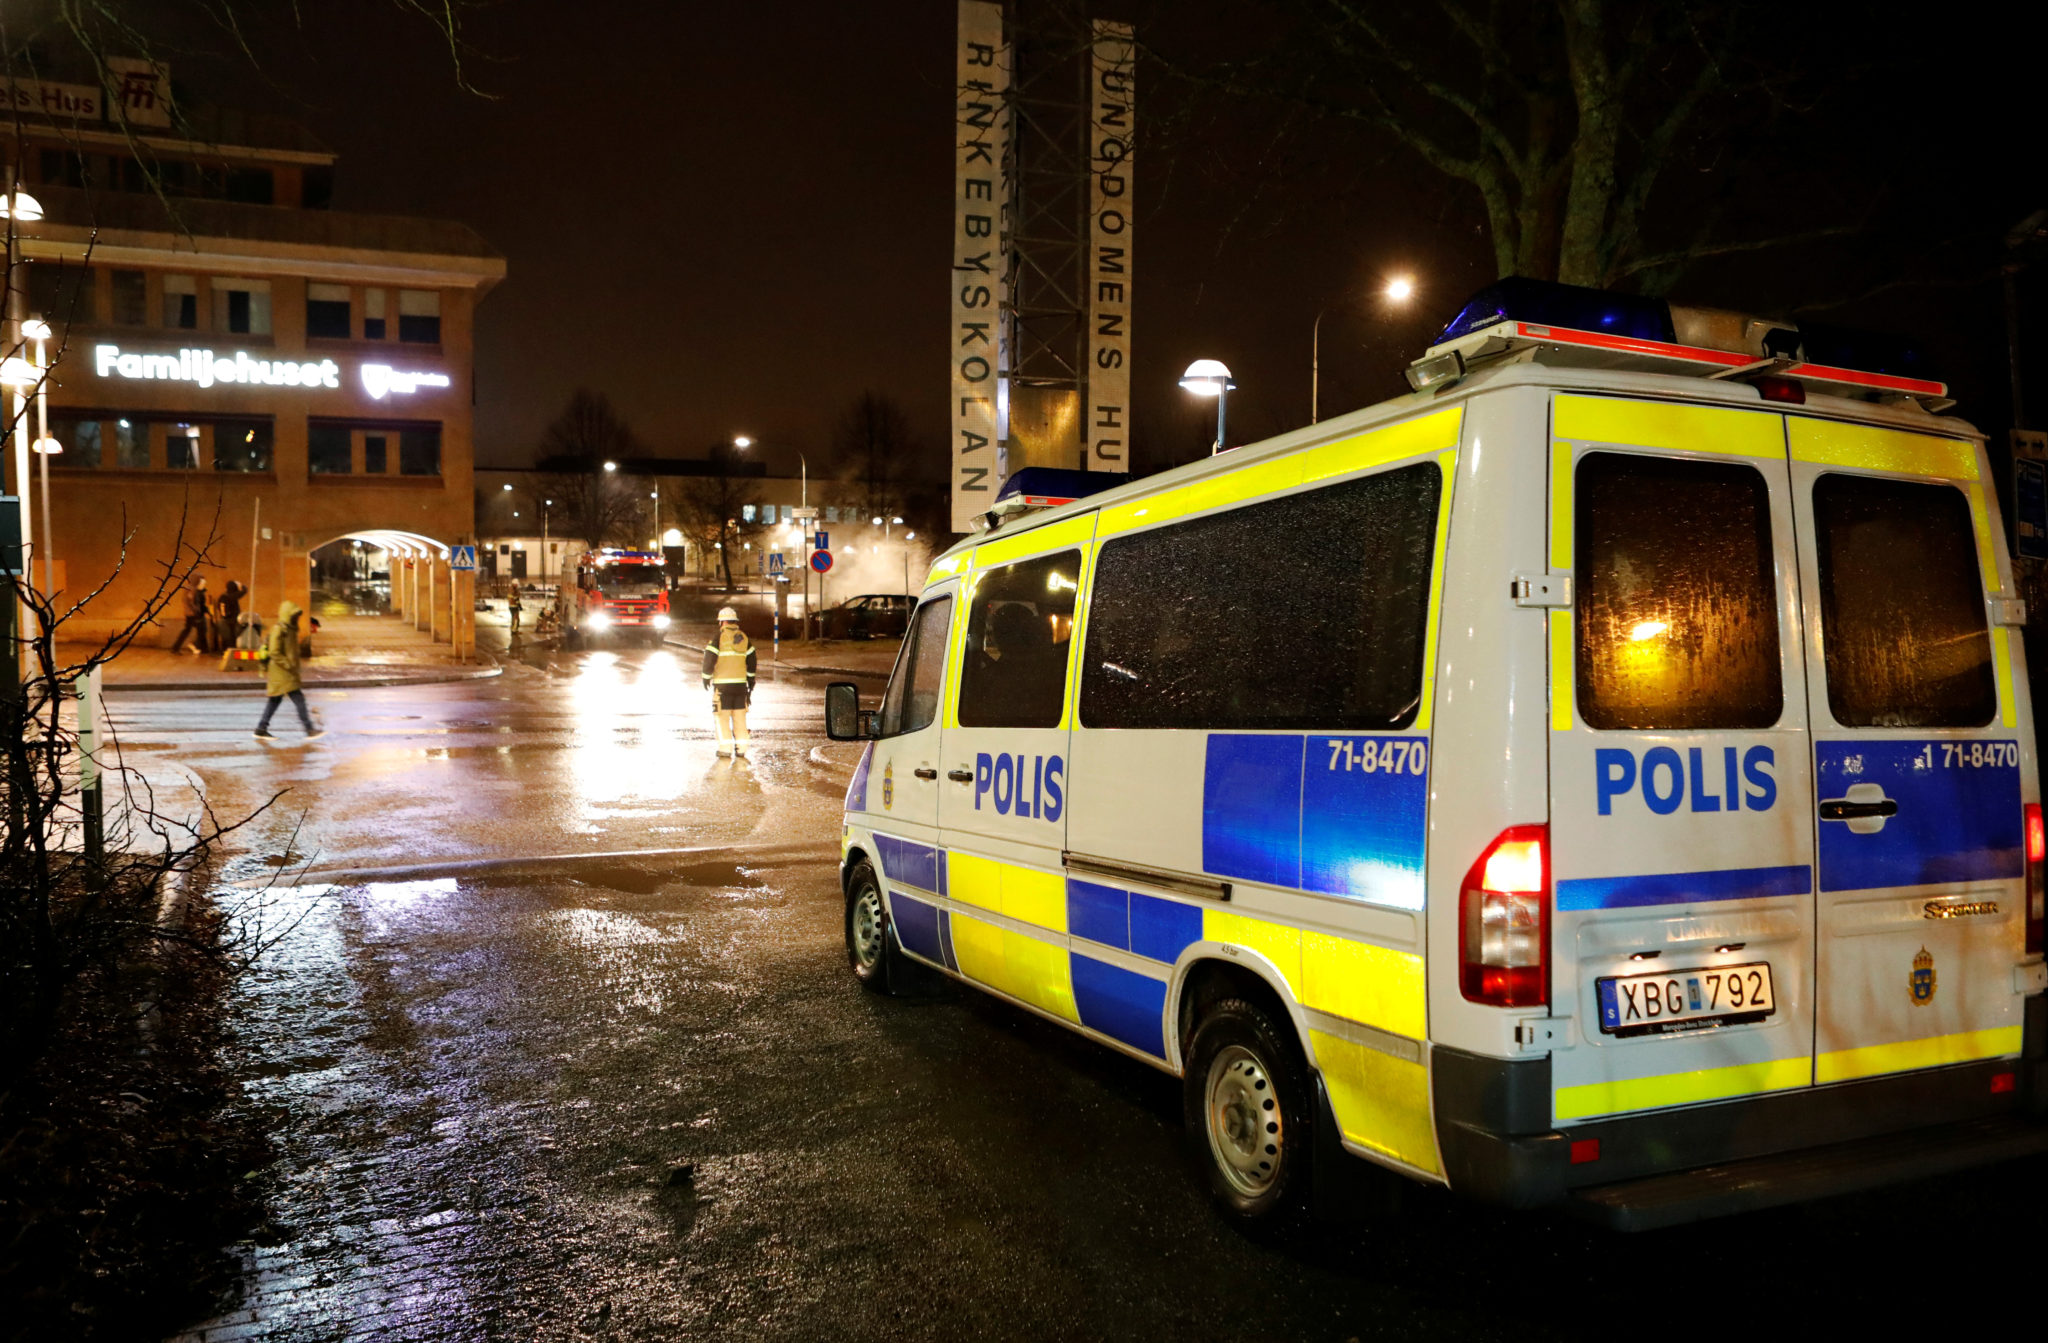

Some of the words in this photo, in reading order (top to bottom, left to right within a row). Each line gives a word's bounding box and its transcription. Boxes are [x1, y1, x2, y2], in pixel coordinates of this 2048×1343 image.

[40, 86, 94, 114] Hus
[1097, 70, 1126, 370] UNGDOMENS
[960, 41, 993, 492] RINKEBYSKOLAN
[95, 344, 340, 388] Familjehuset
[1328, 740, 1426, 776] 71-8470
[1941, 743, 2018, 768] 71-8470
[975, 752, 1065, 823] POLIS
[1595, 745, 1777, 816] POLIS
[1608, 1008, 1615, 1019] S
[1622, 979, 1683, 1020] XBG
[1706, 971, 1765, 1010] 792
